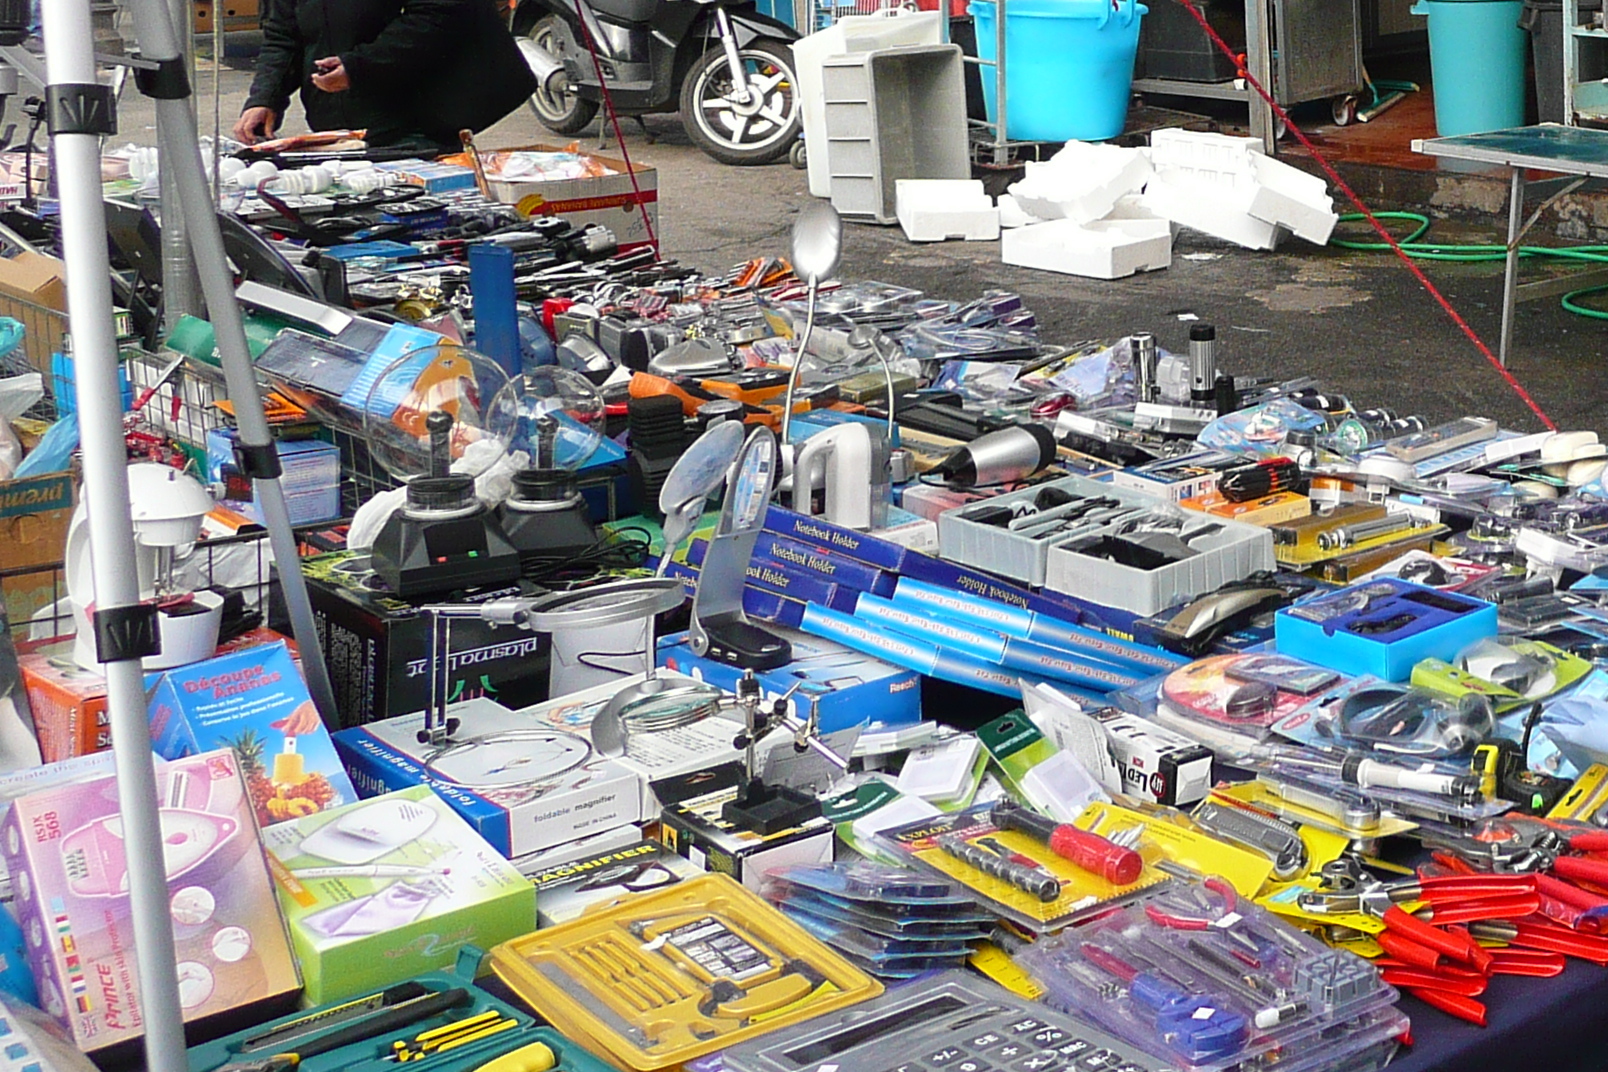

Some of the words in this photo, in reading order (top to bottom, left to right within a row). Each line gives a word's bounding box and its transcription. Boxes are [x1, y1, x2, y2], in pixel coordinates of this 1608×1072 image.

[794, 520, 831, 542] Notebook
[832, 532, 860, 550] Holder
[771, 543, 806, 565] Notebook
[807, 555, 836, 575] Holder
[762, 568, 790, 588] Holder
[956, 574, 988, 594] Holder
[989, 585, 1030, 610] Notebook
[460, 636, 538, 666] plasma
[183, 664, 265, 694] Découpe
[213, 671, 282, 700] Ananas
[358, 739, 420, 774] magnifier
[534, 807, 571, 823] foldable
[574, 794, 617, 811] magnifier
[44, 810, 62, 840] 568
[573, 820, 590, 830] MADE
[974, 1034, 999, 1045] CE
